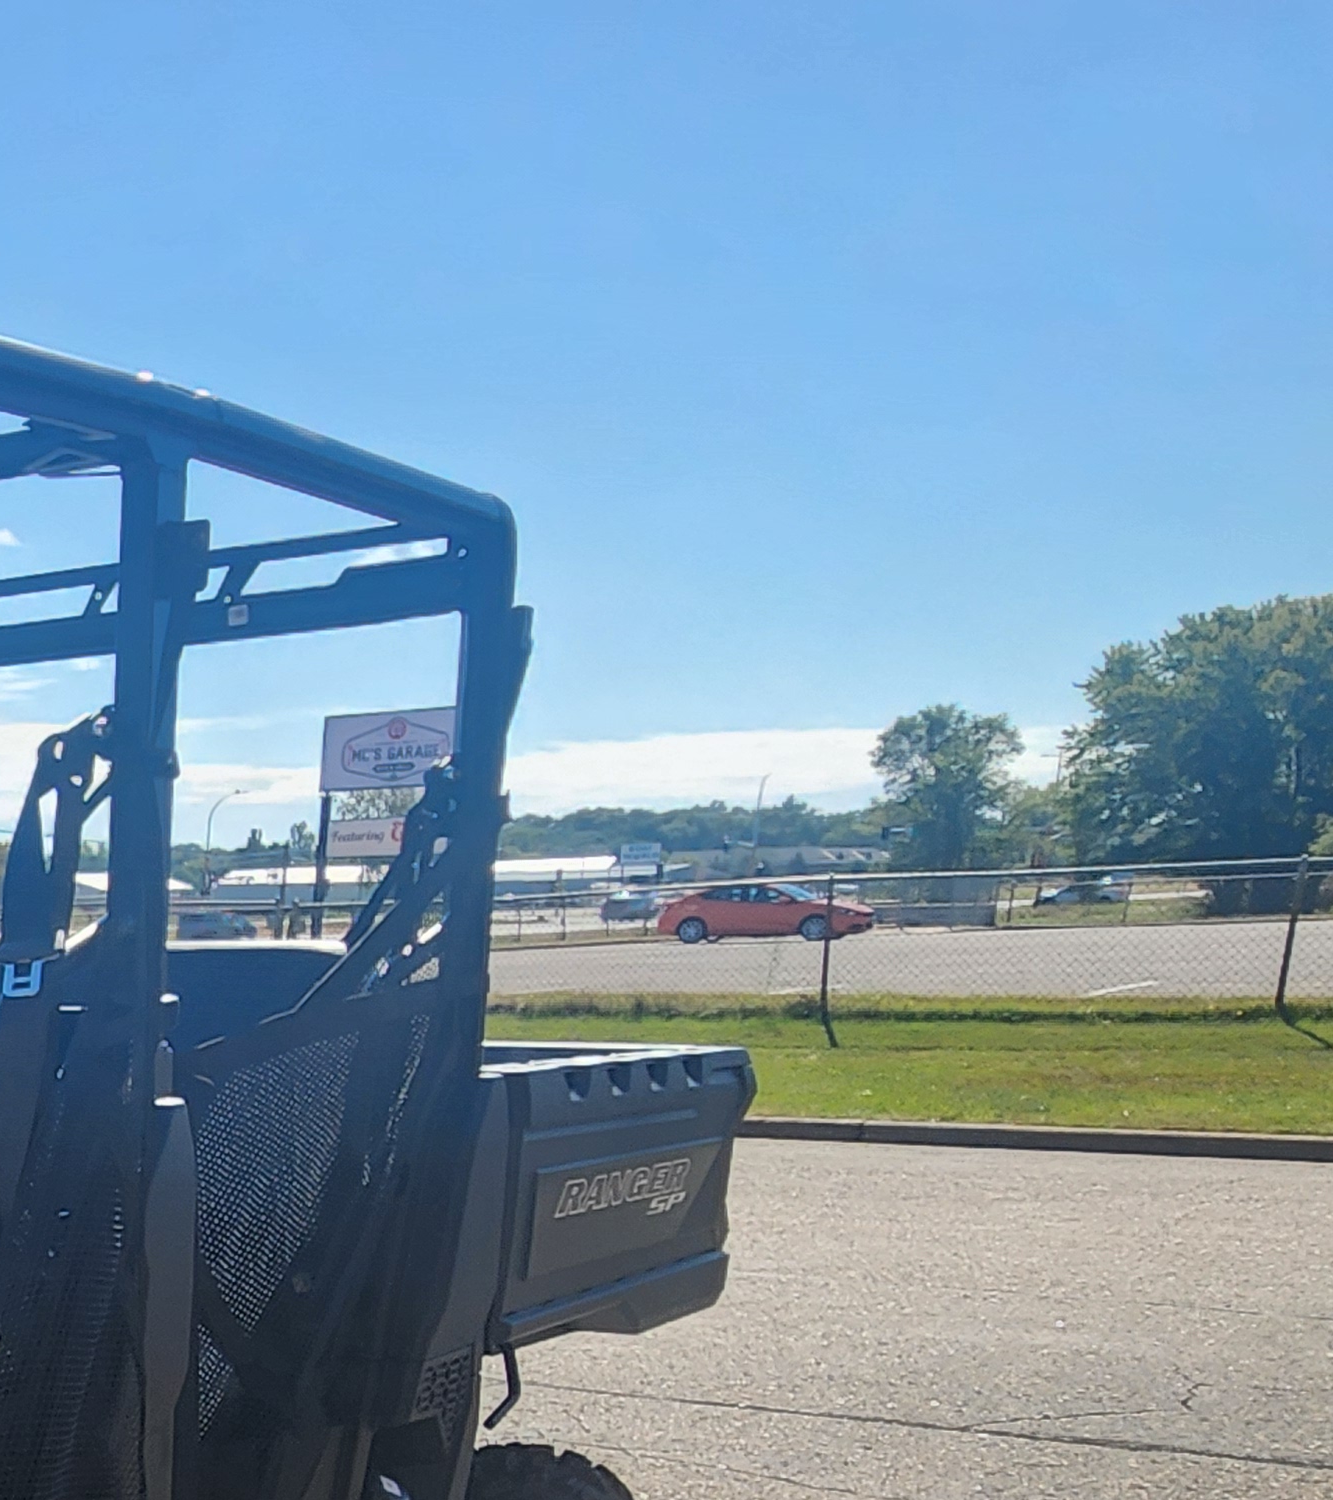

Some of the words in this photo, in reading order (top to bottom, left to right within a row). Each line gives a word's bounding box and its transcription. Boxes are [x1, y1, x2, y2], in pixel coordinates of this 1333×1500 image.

[387, 744, 439, 761] GARAGE
[554, 1158, 691, 1219] RANGER
[646, 1191, 687, 1216] SP
